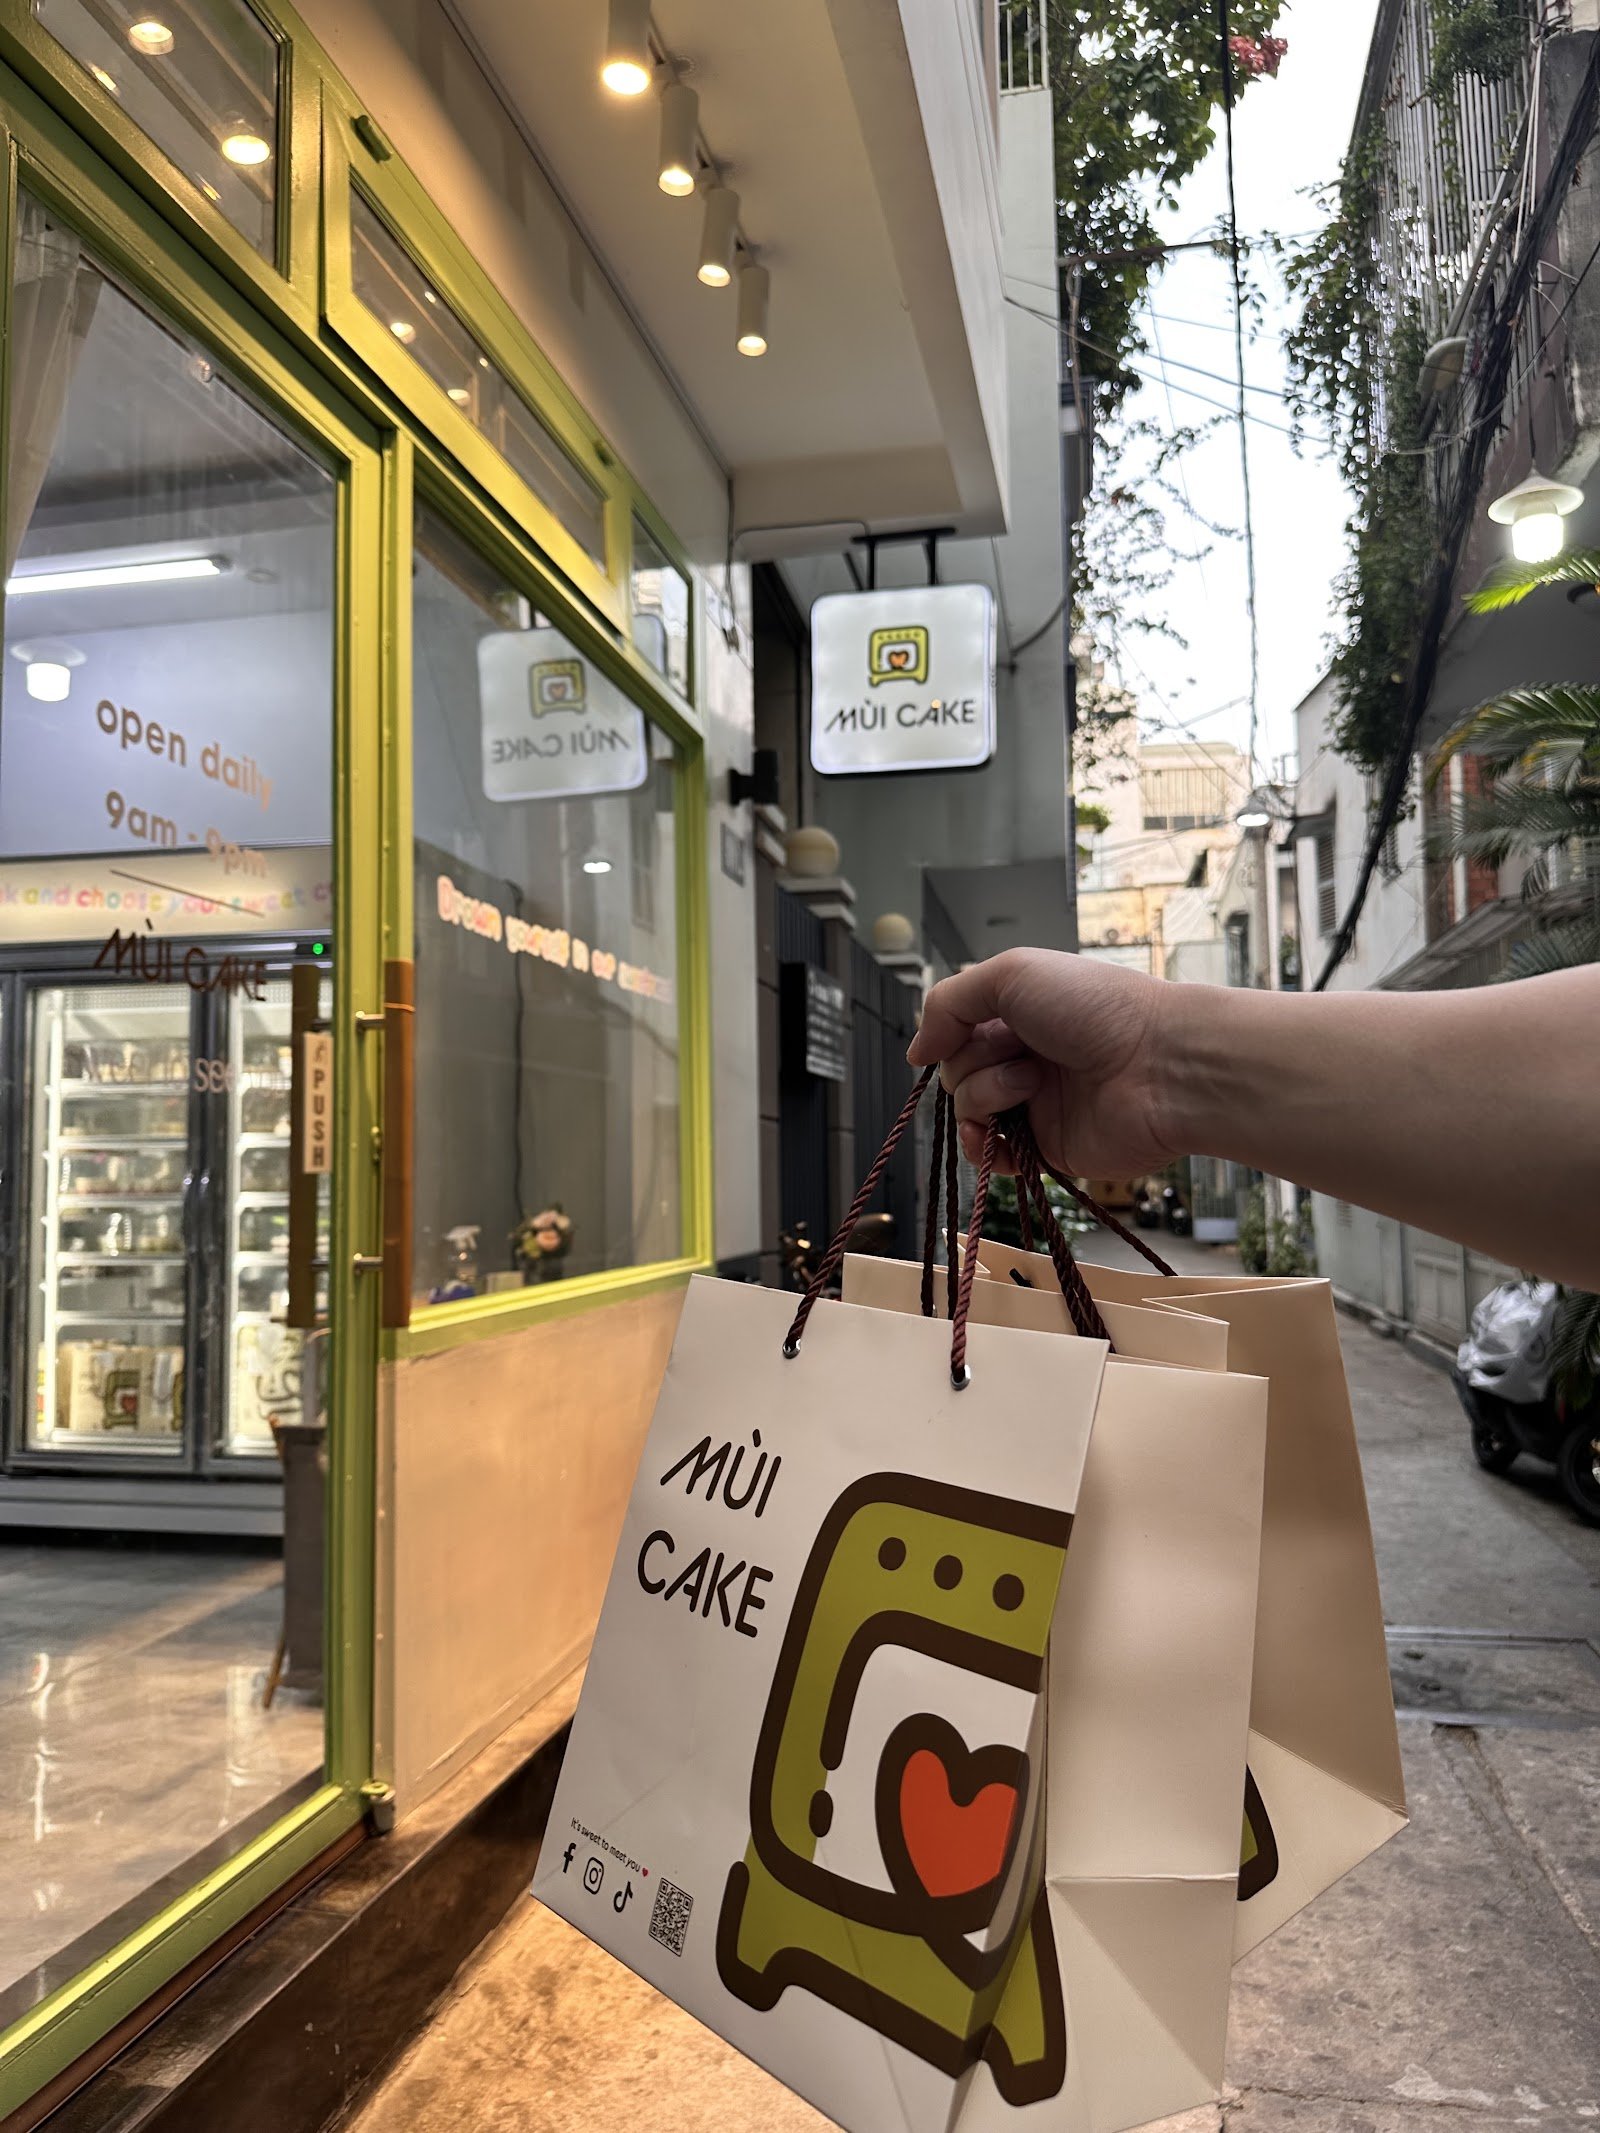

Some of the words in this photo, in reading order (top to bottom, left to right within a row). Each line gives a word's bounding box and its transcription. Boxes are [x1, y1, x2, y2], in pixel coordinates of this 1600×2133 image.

[96, 699, 188, 767] open
[201, 742, 273, 813] daily
[825, 698, 886, 733] MÙI
[896, 699, 975, 728] CAKE
[106, 790, 178, 848] 9am
[206, 827, 269, 879] 9pm
[94, 918, 172, 984] MÙI
[183, 947, 267, 1002] CAKE
[312, 1069, 326, 1167] PUSH
[660, 1428, 781, 1518] MÙI
[637, 1529, 774, 1638] CAKE
[581, 1826, 601, 1846] sweet
[601, 1839, 610, 1851] to
[609, 1845, 627, 1863] meet
[625, 1857, 641, 1873] you
